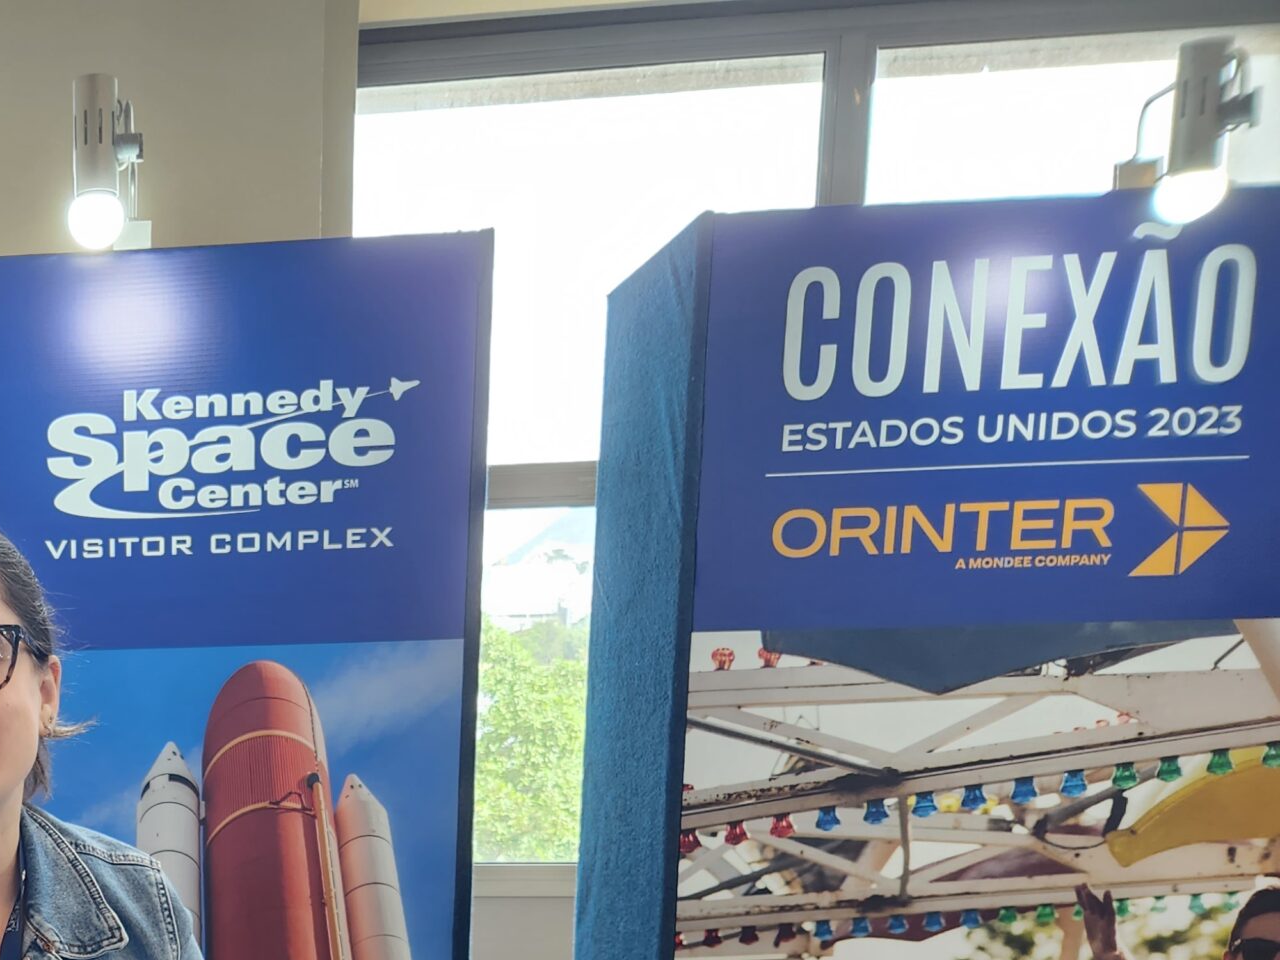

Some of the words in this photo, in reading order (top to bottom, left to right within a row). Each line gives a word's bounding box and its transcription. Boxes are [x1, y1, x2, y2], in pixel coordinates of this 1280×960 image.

[782, 222, 1257, 402] CONEXÃO
[123, 379, 370, 421] Kennedy
[781, 415, 964, 453] ESTADOS
[977, 408, 1137, 443] UNIDOS
[1148, 405, 1243, 438] 2023
[47, 412, 396, 492] Space
[158, 476, 343, 510] Center
[45, 534, 194, 560] VISITOR
[210, 526, 395, 555] COMPLEX
[771, 498, 1115, 559] ORINTER
[955, 559, 967, 570] A
[969, 556, 1032, 569] MONDEE
[1034, 553, 1111, 568] COMPANY
